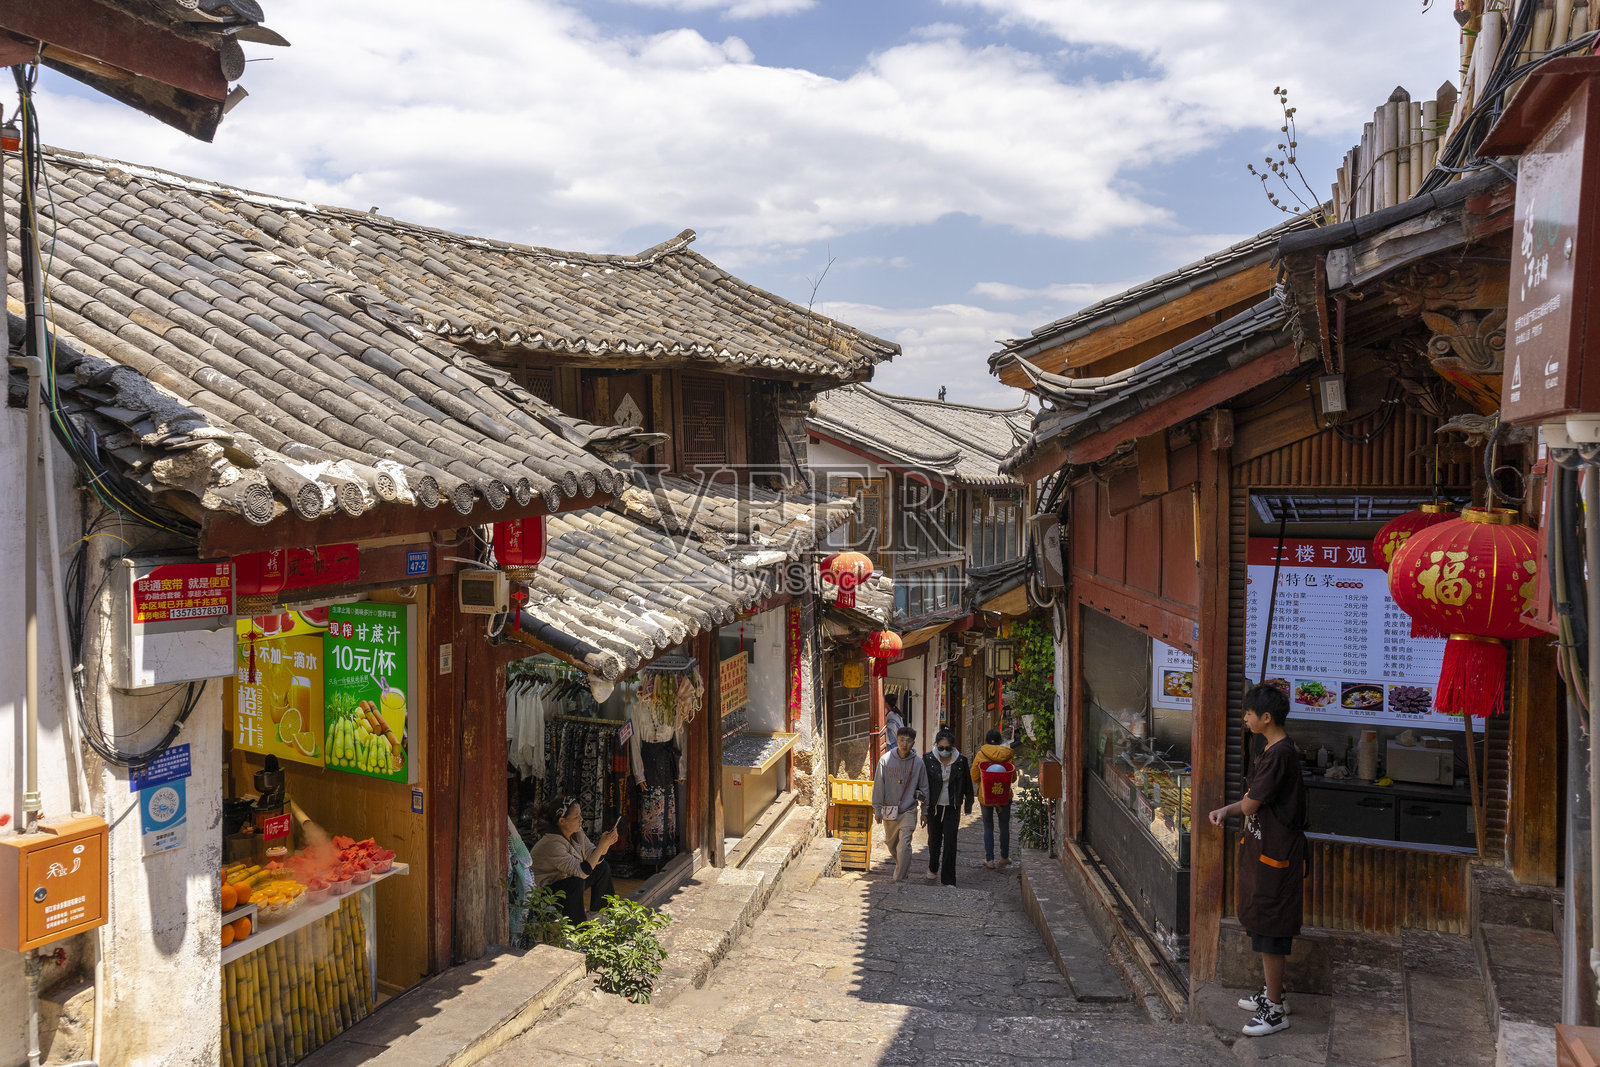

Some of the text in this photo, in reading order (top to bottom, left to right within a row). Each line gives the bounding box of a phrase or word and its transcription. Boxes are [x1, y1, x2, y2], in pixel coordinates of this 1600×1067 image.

[1271, 544, 1367, 564] 二楼可观
[410, 561, 426, 572] 47-2
[138, 576, 230, 592] 联通宽带 就是便宜
[1286, 573, 1335, 588] 特色菜
[1417, 550, 1473, 607] 福
[139, 597, 227, 610] 本区域已开通千兆宽带
[171, 606, 228, 618] 13578378370
[259, 646, 317, 670] 不加一滴水
[332, 645, 396, 676] 10元/杯
[1384, 662, 1412, 670] 水煮肉片
[238, 685, 257, 747] 橙汁
